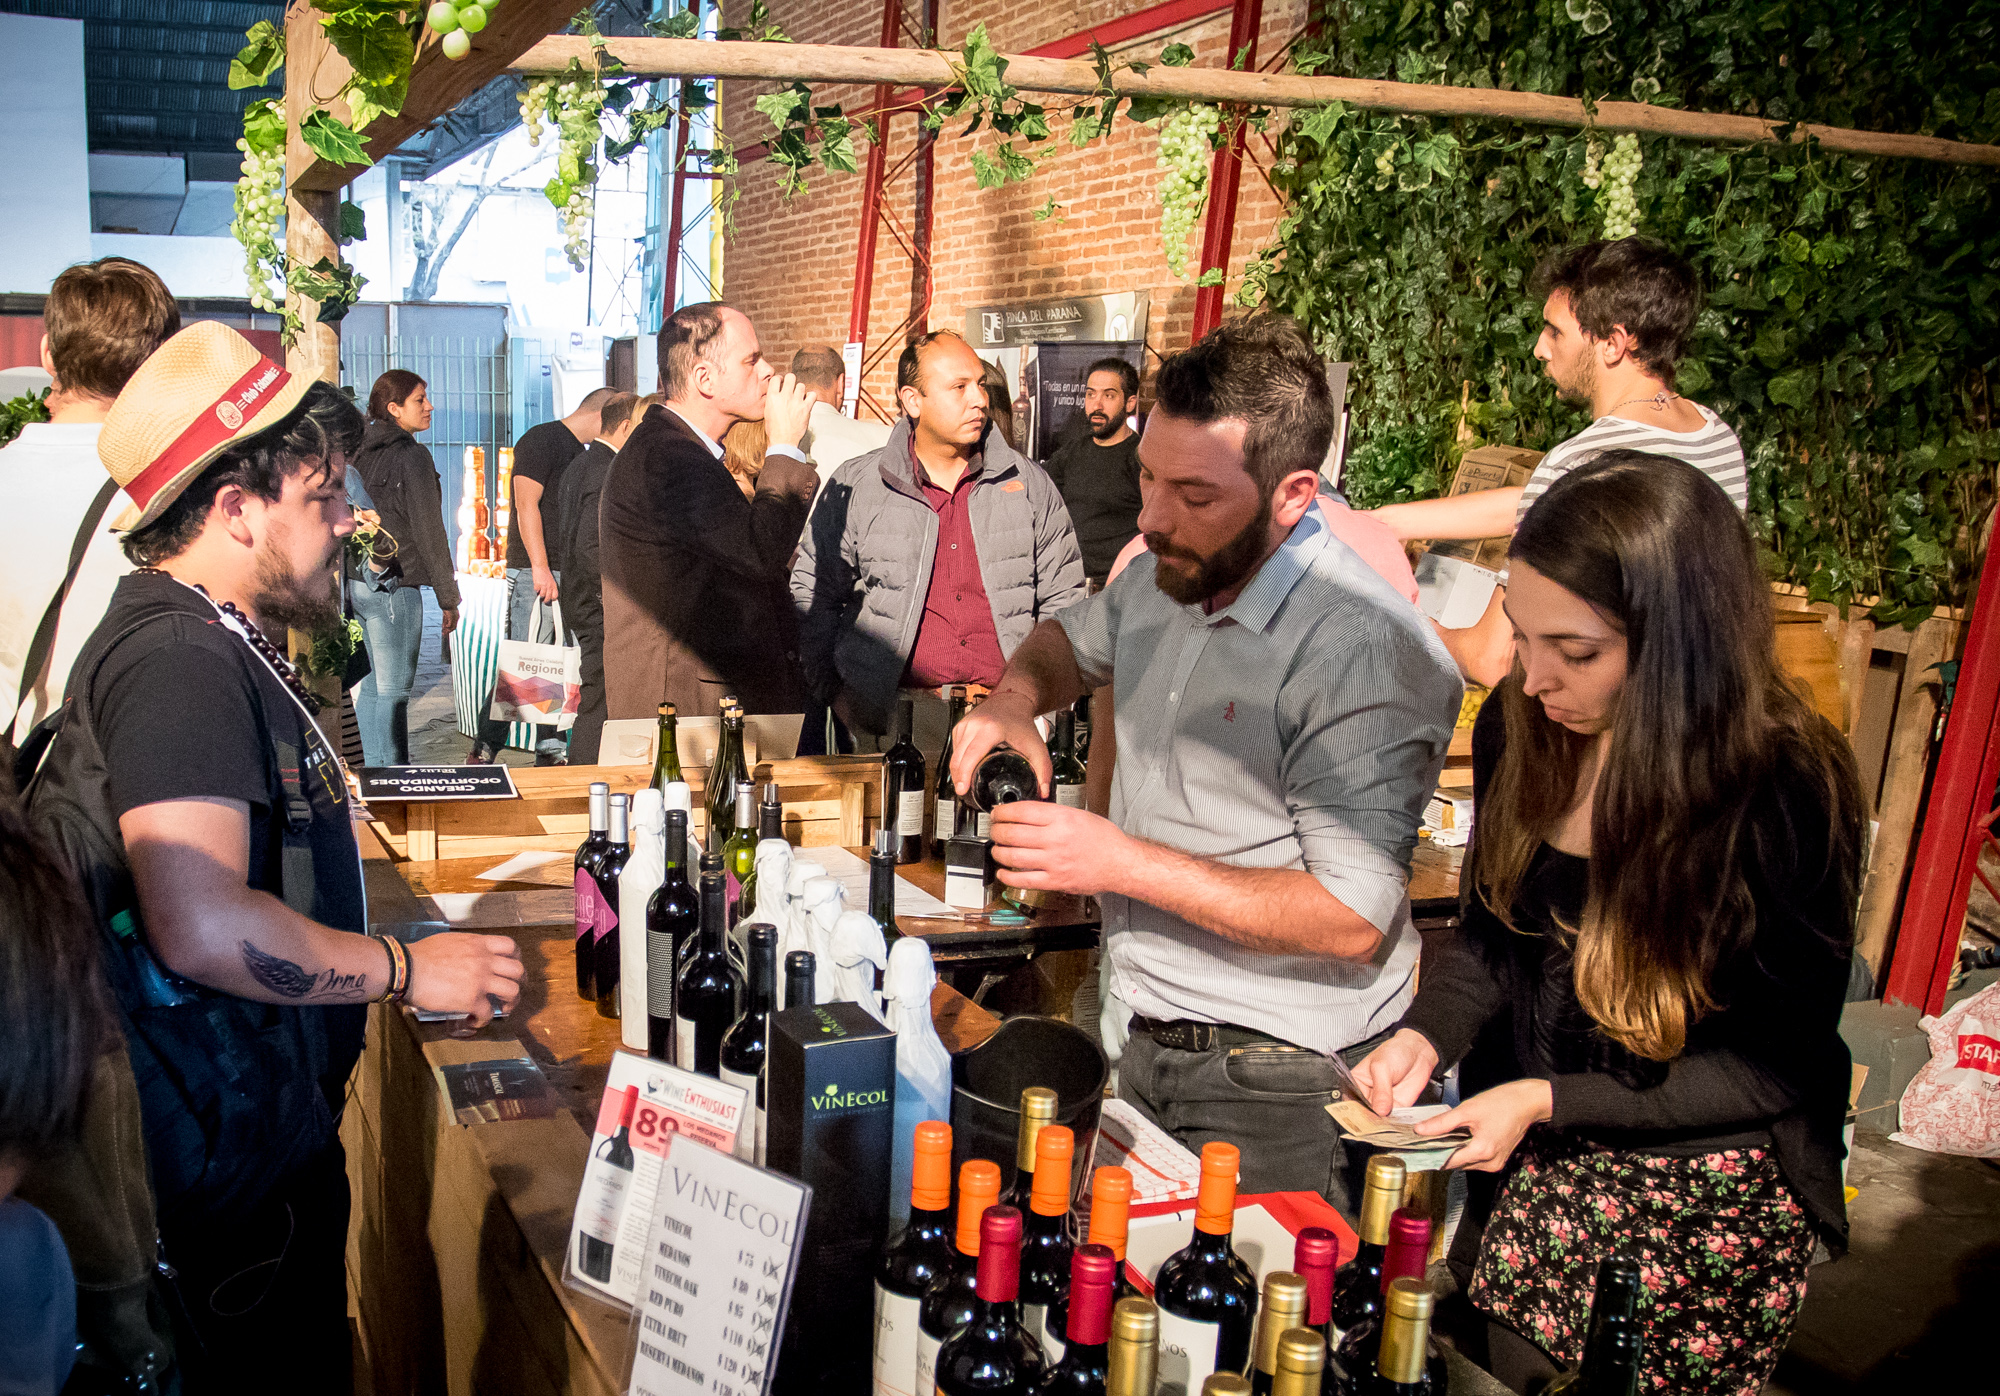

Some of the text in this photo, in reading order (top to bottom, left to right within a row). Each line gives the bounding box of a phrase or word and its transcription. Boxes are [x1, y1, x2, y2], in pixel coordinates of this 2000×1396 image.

[1006, 311, 1028, 323] FINCA
[1030, 310, 1043, 322] DEL
[241, 387, 259, 404] Club
[1062, 384, 1071, 393] en
[1076, 395, 1086, 409] lug
[304, 748, 326, 769] THE
[370, 777, 501, 786] OPORTUNIDADES
[684, 1087, 737, 1122] ENTHUSIAST
[635, 1108, 680, 1144] 89
[682, 1120, 696, 1131] LOS
[673, 1167, 792, 1247] VINECOL
[664, 1215, 693, 1240] VINECOL
[615, 1265, 639, 1284] VINE
[654, 1264, 682, 1291] VINECOL
[683, 1281, 699, 1298] OAK
[649, 1290, 664, 1307] RED
[664, 1297, 684, 1318] PURO
[643, 1315, 667, 1337] EXTRA
[667, 1327, 688, 1348] BRUT
[640, 1340, 671, 1367] RESERVA
